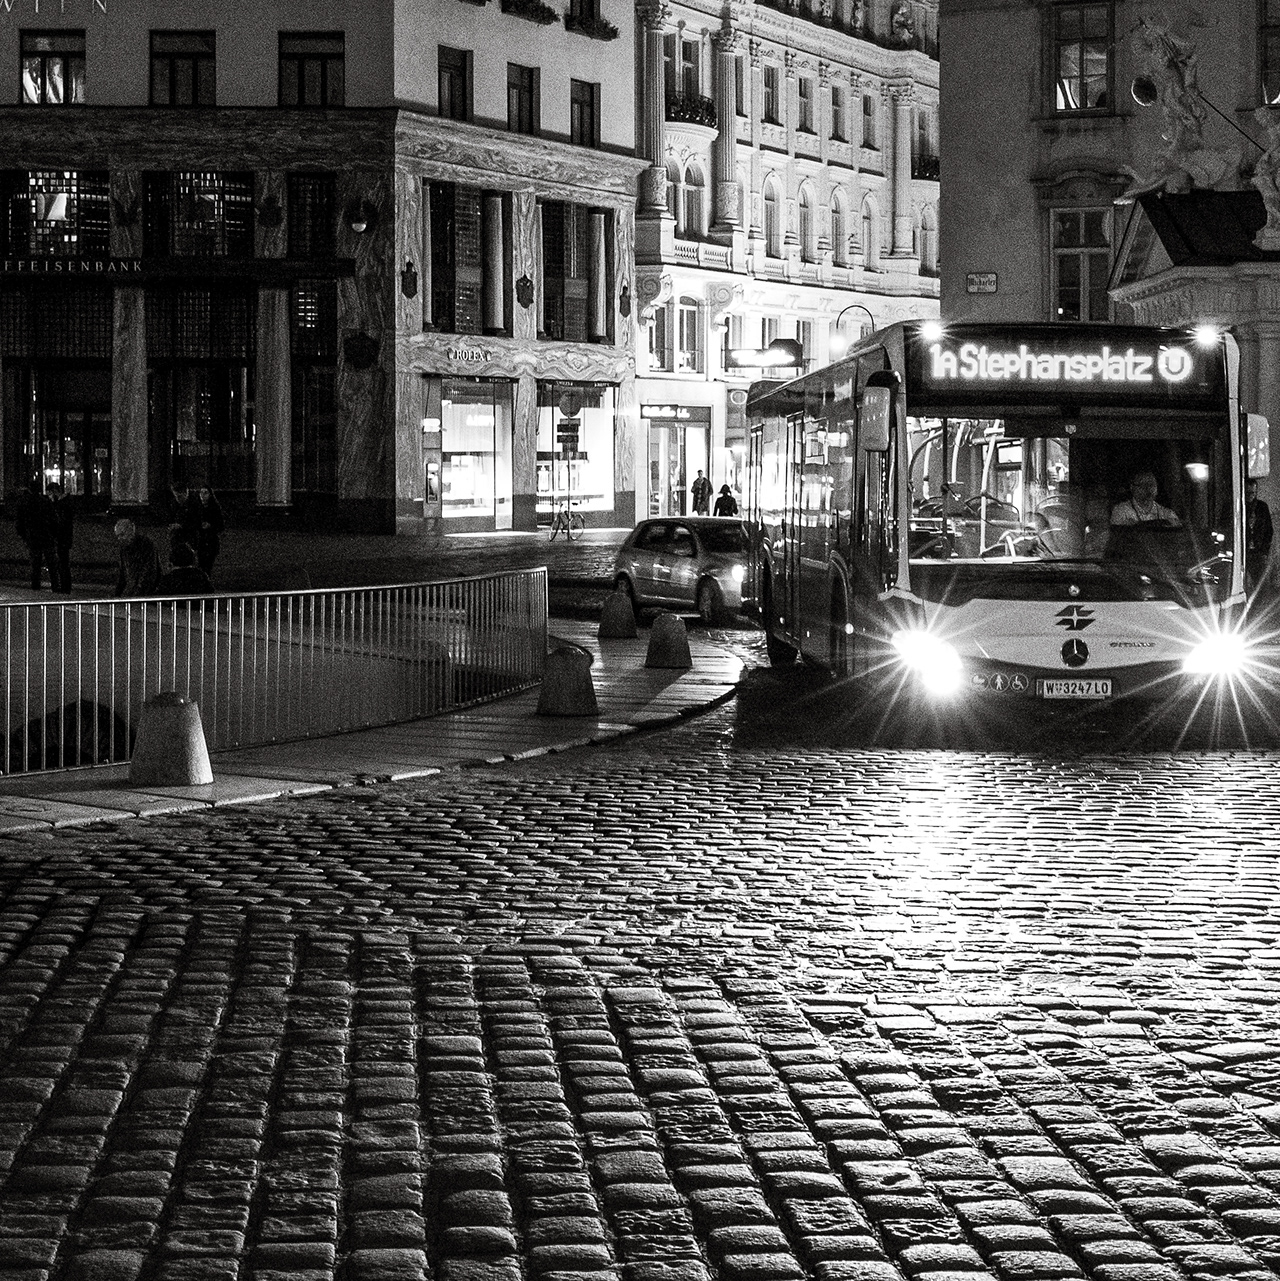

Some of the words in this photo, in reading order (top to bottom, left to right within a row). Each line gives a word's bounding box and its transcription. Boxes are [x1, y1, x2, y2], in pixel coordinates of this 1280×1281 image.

[456, 349, 485, 361] ROLEX
[929, 343, 958, 379] 1A
[959, 343, 1153, 381] Stephansplatz
[1046, 682, 1054, 694] W
[1063, 682, 1092, 694] 3247
